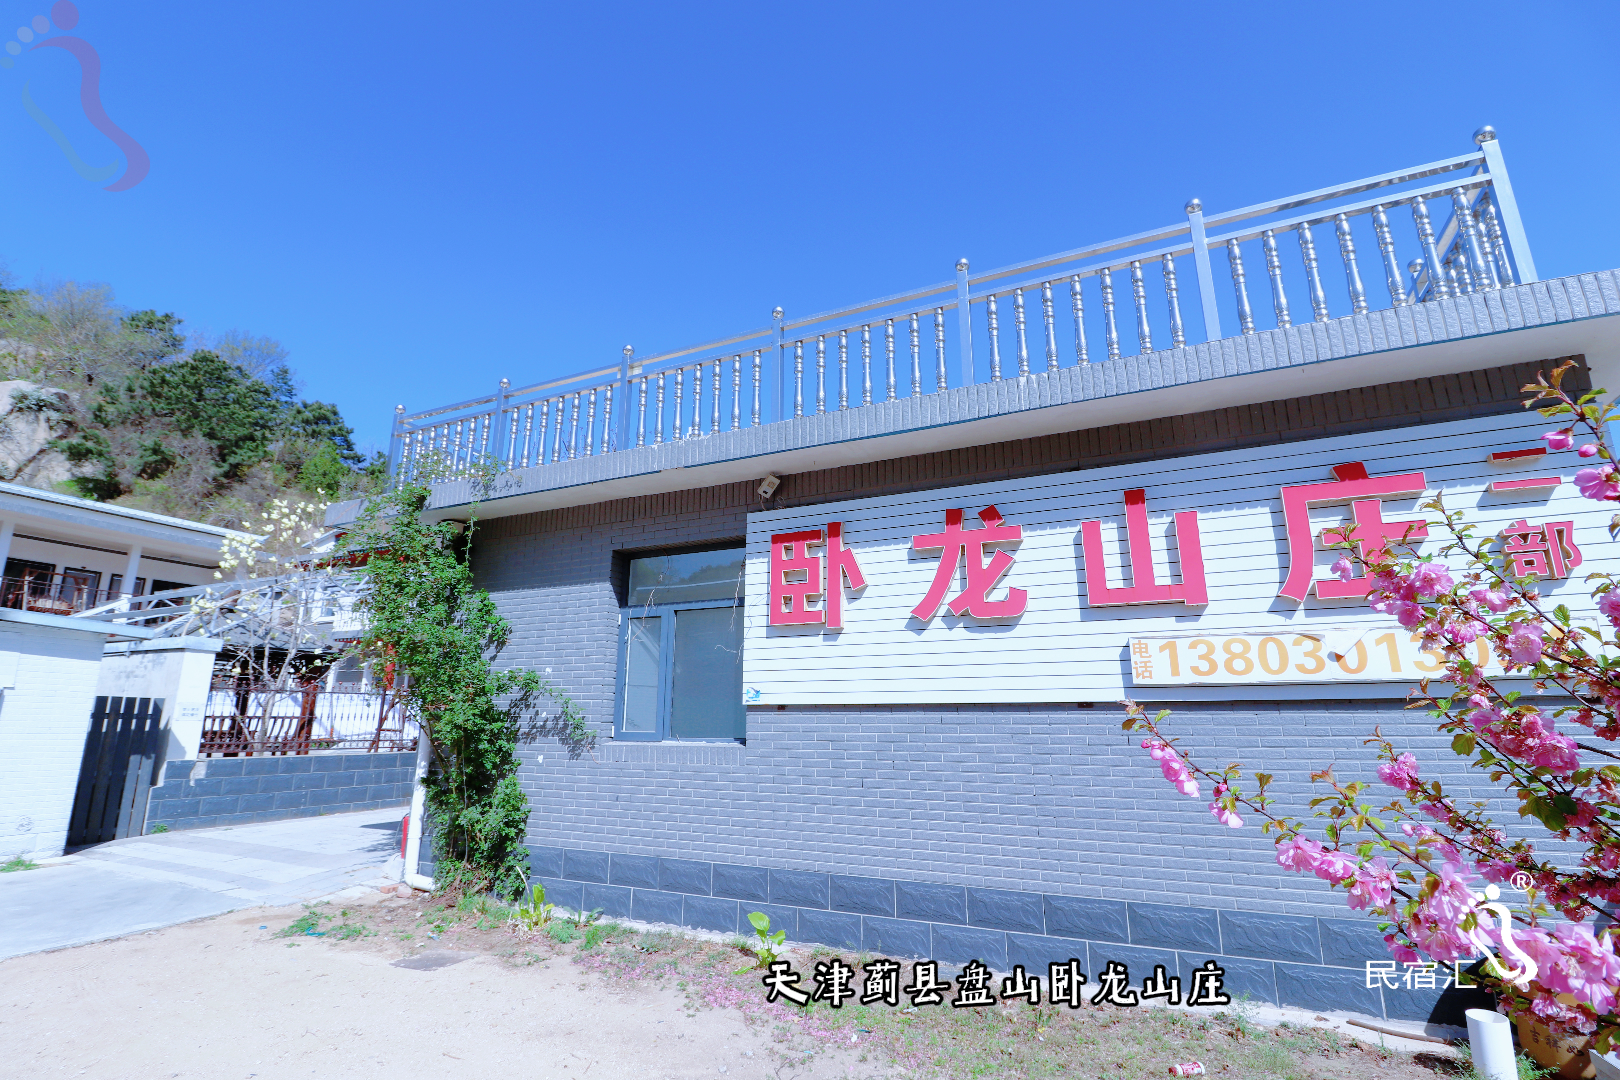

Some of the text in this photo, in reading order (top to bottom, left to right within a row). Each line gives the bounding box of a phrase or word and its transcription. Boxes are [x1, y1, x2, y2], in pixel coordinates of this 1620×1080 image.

[769, 461, 1429, 629] 卧龙山庄
[1131, 639, 1154, 680] 电话
[1158, 625, 1571, 678] 13803013
